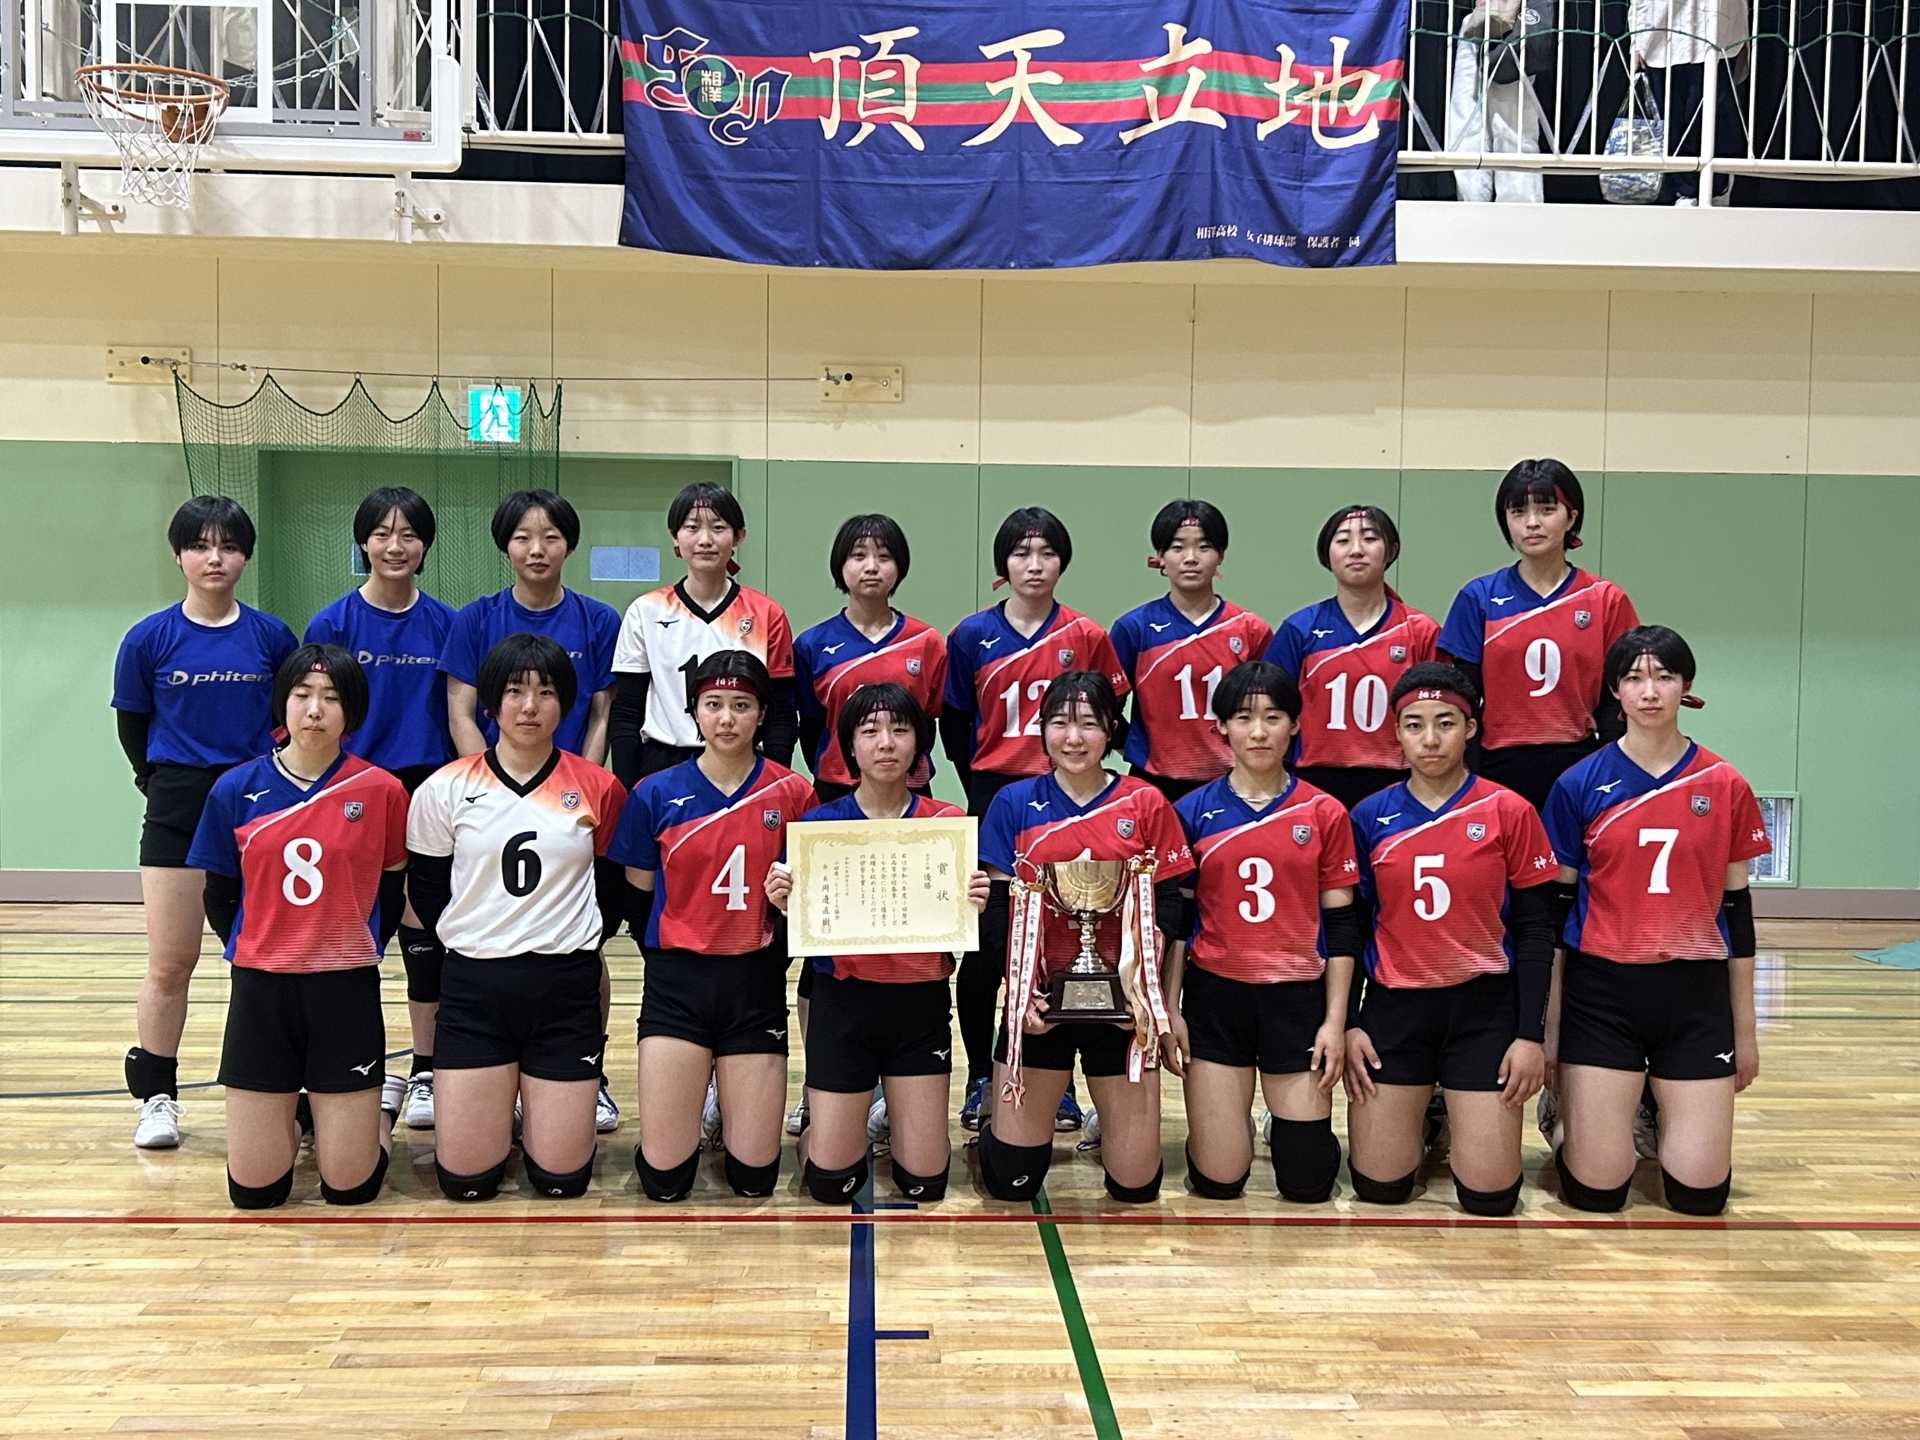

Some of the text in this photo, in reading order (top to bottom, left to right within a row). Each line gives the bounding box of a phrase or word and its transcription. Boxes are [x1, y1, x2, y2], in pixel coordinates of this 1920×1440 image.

[809, 23, 1390, 150] 頂天立地
[678, 654, 699, 714] 1
[1174, 664, 1222, 721] 11
[1525, 638, 1561, 697] 9
[1325, 672, 1388, 733] 10
[282, 837, 324, 906] 8
[501, 830, 542, 898] 6
[711, 844, 750, 911] 4
[1238, 857, 1276, 923] 3
[1413, 853, 1451, 921] 5
[1638, 828, 1680, 894] 7
